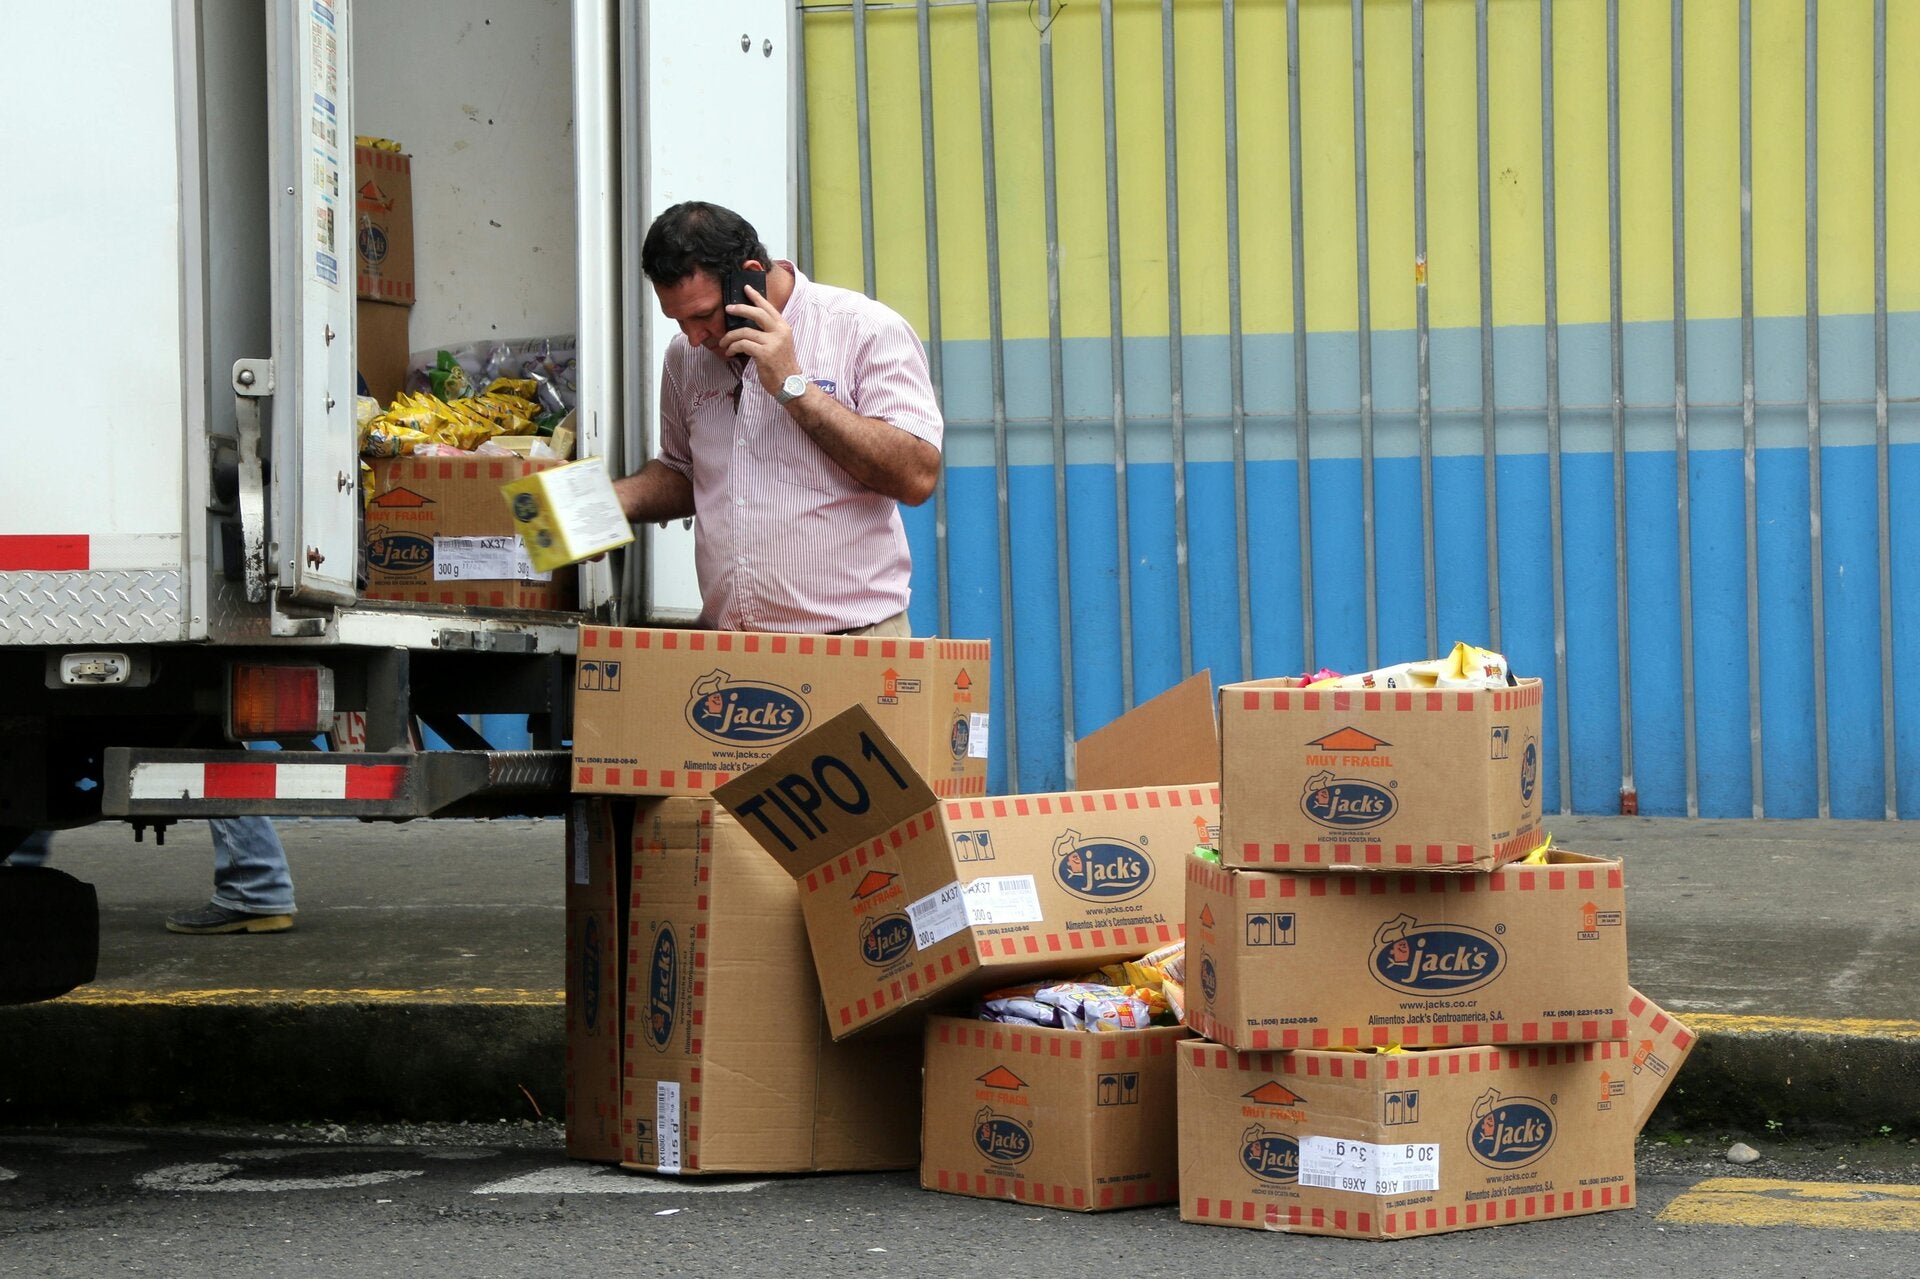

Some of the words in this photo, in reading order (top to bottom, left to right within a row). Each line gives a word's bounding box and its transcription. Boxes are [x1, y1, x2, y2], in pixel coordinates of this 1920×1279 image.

[395, 511, 436, 521] FRAGIL
[480, 539, 506, 549] AX37
[379, 539, 428, 566] jack's
[438, 563, 451, 575] 300
[453, 566, 459, 577] g
[714, 692, 794, 733] jack's
[712, 751, 772, 759] www.jacks.co
[1306, 755, 1337, 767] MUY
[1343, 755, 1393, 768] FRAGIL
[683, 760, 717, 771] Alimentos
[719, 762, 741, 772] Jack's
[734, 755, 871, 852] TIPO
[859, 731, 909, 791] 1
[1323, 788, 1384, 820] jack's
[1081, 850, 1141, 892] jack's
[968, 882, 991, 894] AX37
[940, 886, 959, 905] AX37
[972, 909, 984, 921] 300
[986, 911, 993, 923] g
[1085, 904, 1143, 916] www.jacks.co.cr
[1065, 920, 1094, 931] Alimentos
[1095, 918, 1113, 928] Jack's
[1586, 915, 1593, 925] 6
[875, 925, 908, 960] jack's
[919, 932, 931, 946] 300
[1402, 937, 1488, 983] jack's
[651, 938, 672, 1023] jack's
[1399, 1000, 1478, 1010] www.jacks.co.cr
[1261, 1018, 1279, 1027] (506)
[1368, 1014, 1405, 1026] Alimentos
[1406, 1013, 1432, 1025] Jack's
[1432, 1012, 1488, 1024] Centroamerica,
[1489, 1010, 1505, 1021] S.A.
[684, 1020, 692, 1055] Alimentos
[1242, 1106, 1265, 1118] MUY
[987, 1124, 1025, 1152] jack's
[1488, 1111, 1546, 1157] jack's
[1337, 1141, 1345, 1155] g
[1405, 1145, 1414, 1158] g
[1418, 1146, 1434, 1161] 30
[1343, 1177, 1366, 1191] AX69
[1485, 1171, 1538, 1184] www.jacks.co.cr
[1375, 1180, 1398, 1193] AX69
[1465, 1190, 1490, 1201] Alimentos
[1490, 1187, 1507, 1198] Jack's
